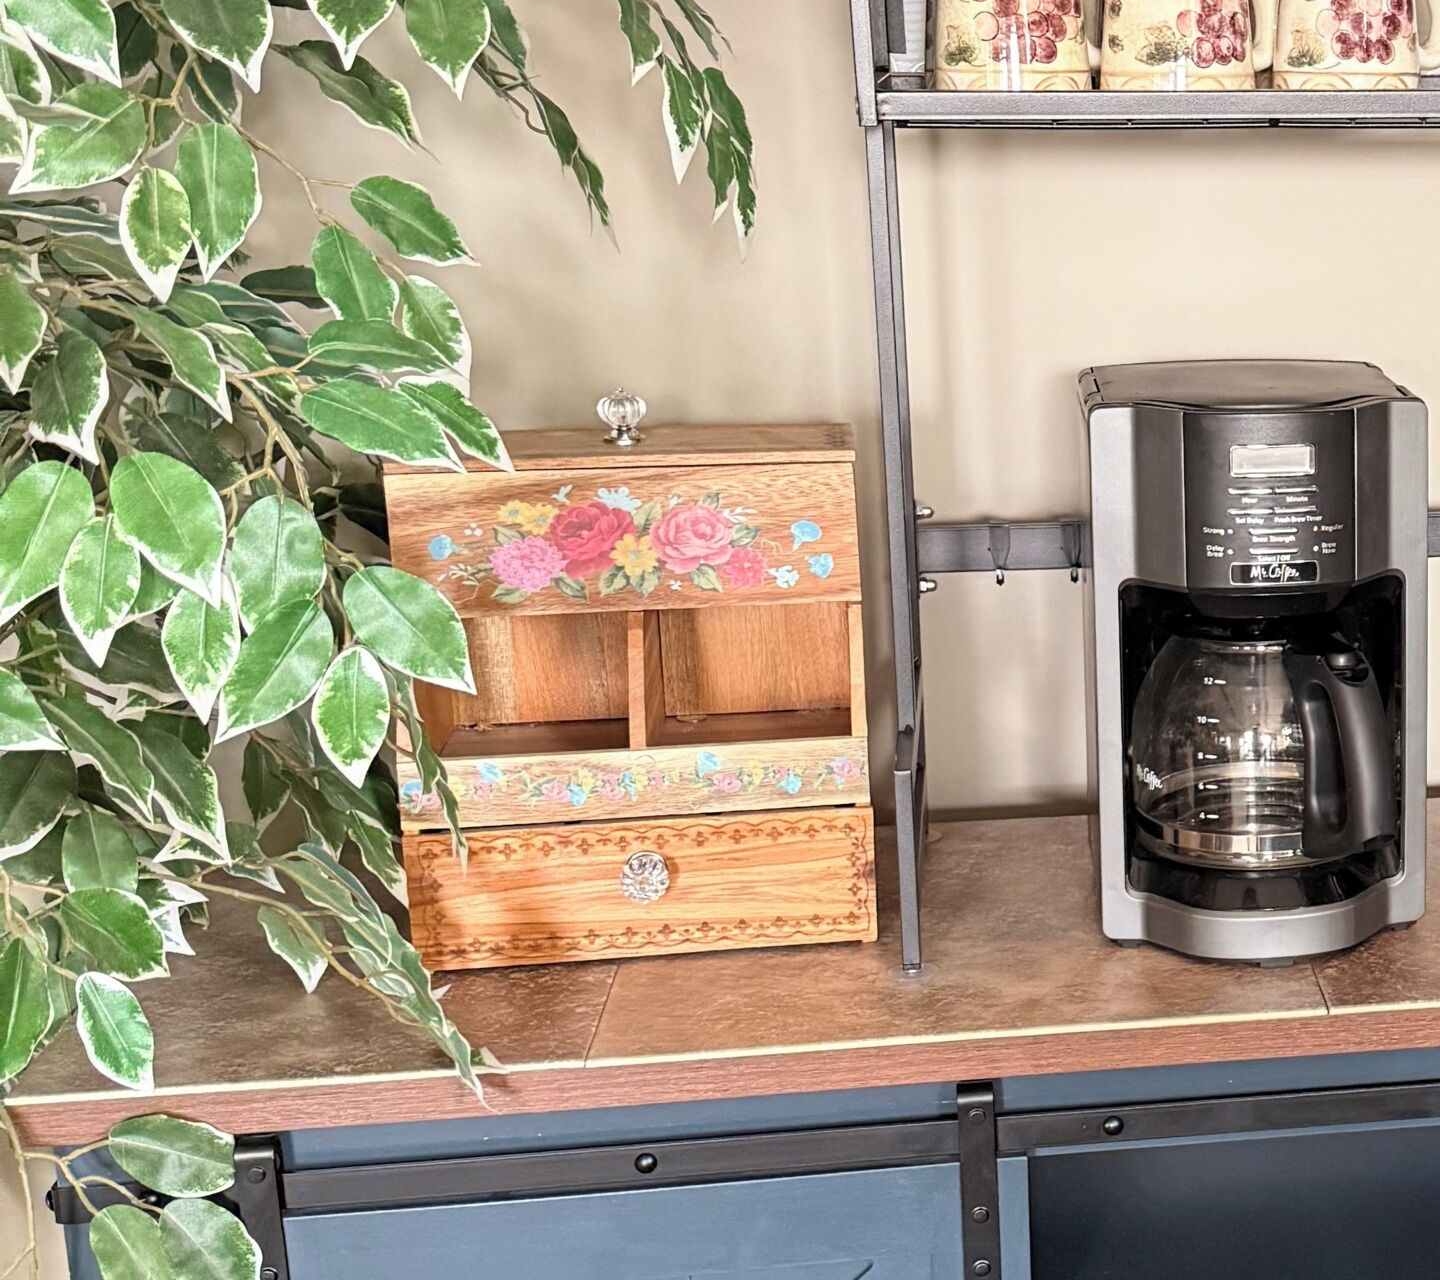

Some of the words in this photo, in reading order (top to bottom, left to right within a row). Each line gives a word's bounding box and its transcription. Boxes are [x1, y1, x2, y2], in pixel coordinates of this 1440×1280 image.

[1321, 524, 1343, 532] Regular
[1251, 566, 1268, 580] Mr.
[1204, 677, 1213, 685] 12
[1197, 716, 1207, 724] 10
